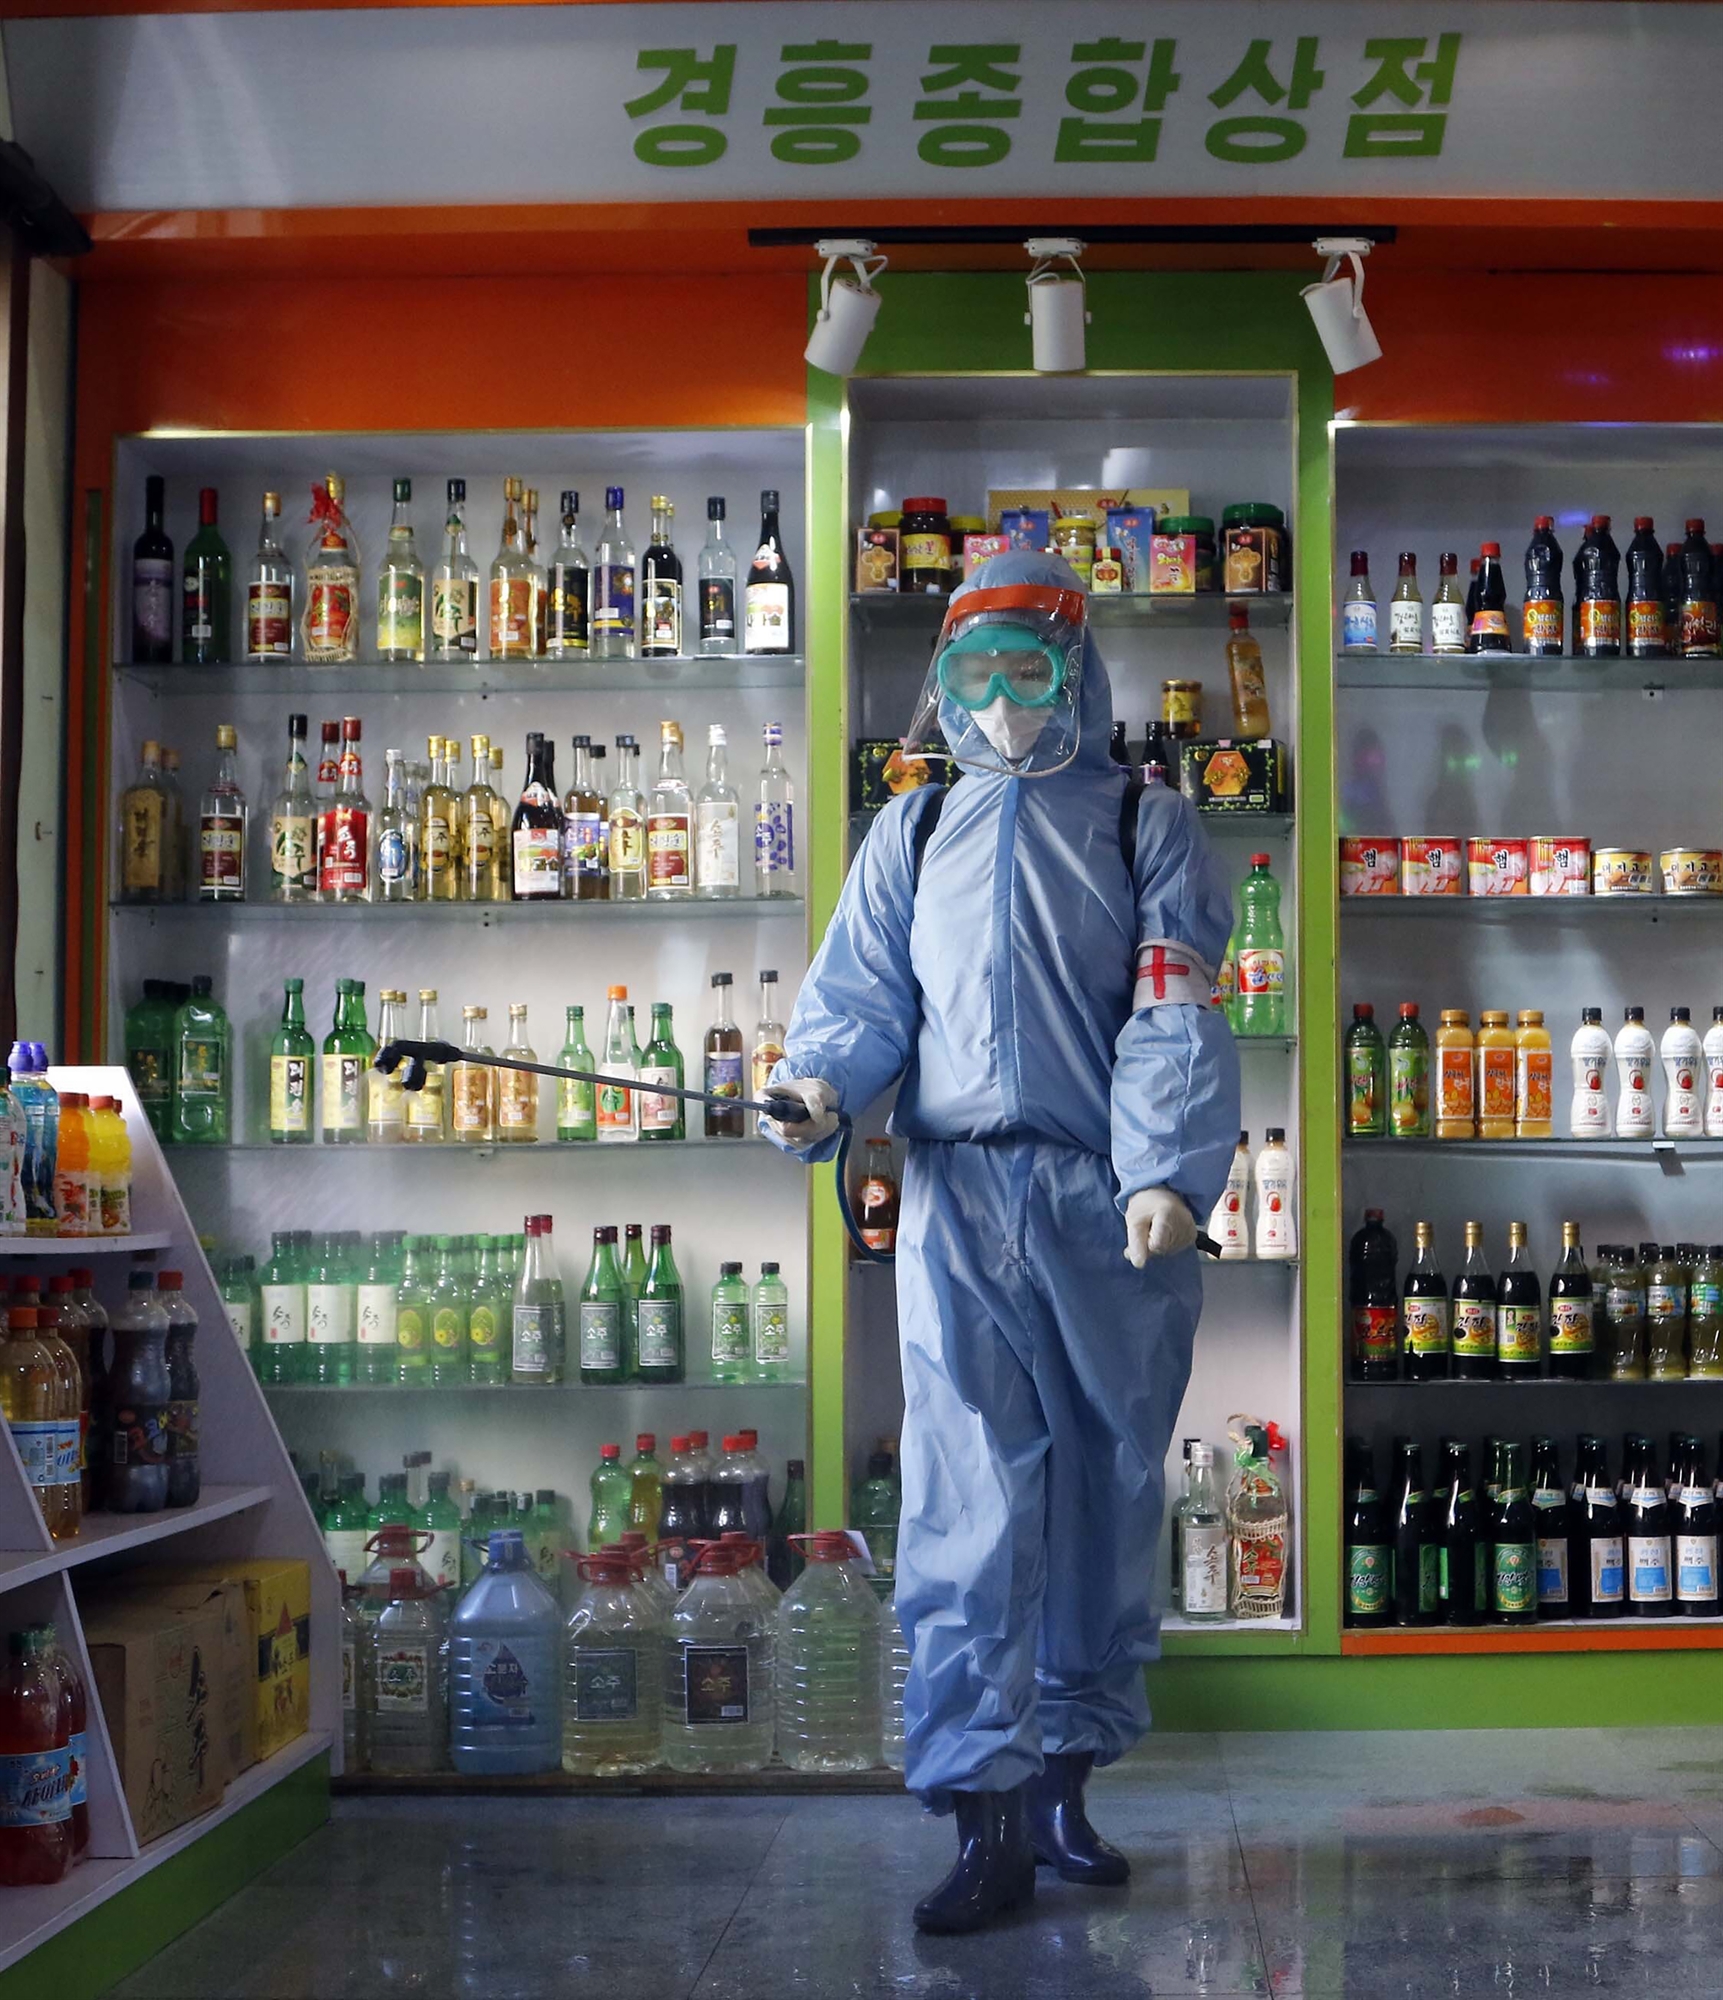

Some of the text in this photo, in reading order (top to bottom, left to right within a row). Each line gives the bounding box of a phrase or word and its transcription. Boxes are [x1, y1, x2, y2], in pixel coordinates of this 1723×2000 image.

[624, 32, 1462, 167] 경흥종합상점
[1363, 849, 1377, 868] 햄
[1426, 849, 1441, 868] 햄
[1494, 850, 1508, 869] 햄
[1554, 849, 1569, 868] 햄
[1457, 1316, 1486, 1330] 간장
[1552, 1313, 1578, 1327] 간장
[520, 1330, 542, 1343] 소주
[586, 1326, 608, 1340] 소주
[646, 1323, 668, 1338] 소주
[721, 1323, 743, 1335] 소주
[764, 1323, 785, 1336] 소주
[1203, 1545, 1220, 1585] 소주
[388, 1668, 419, 1683] 소주
[589, 1675, 621, 1690] 소주
[700, 1676, 731, 1693] 소주
